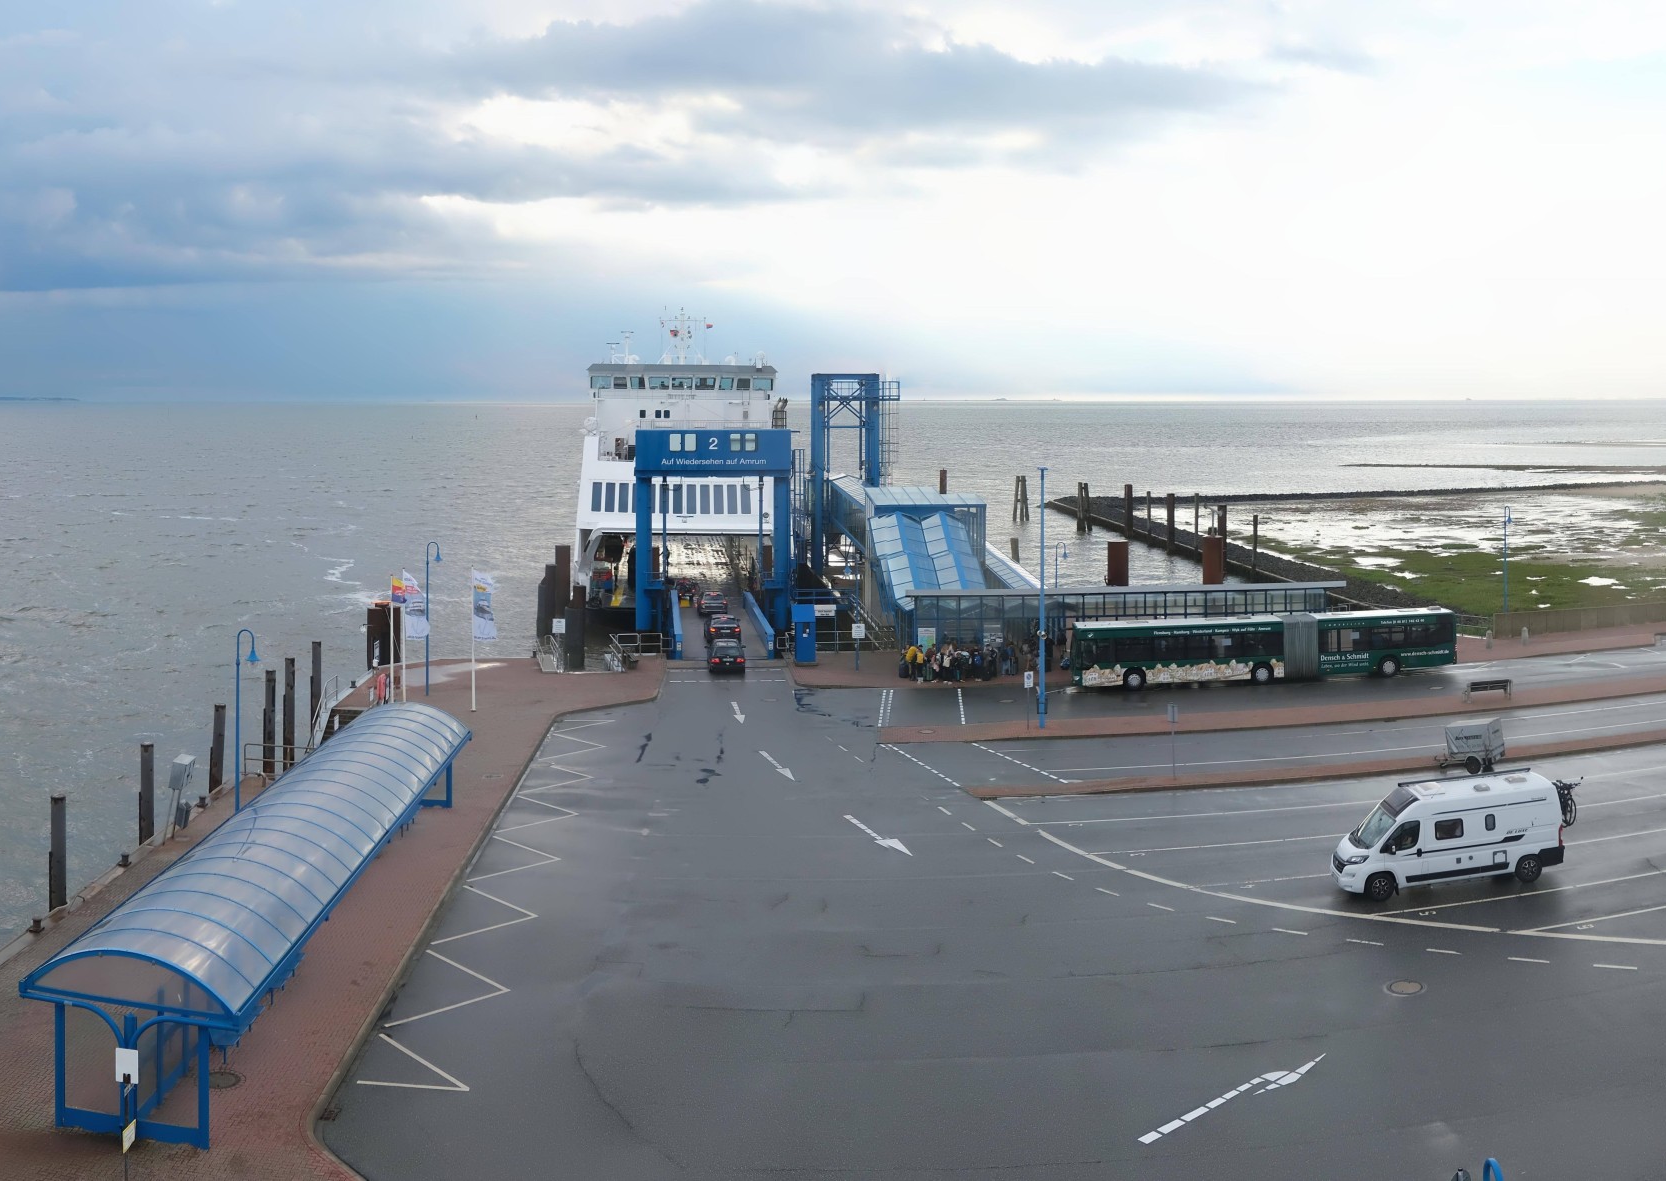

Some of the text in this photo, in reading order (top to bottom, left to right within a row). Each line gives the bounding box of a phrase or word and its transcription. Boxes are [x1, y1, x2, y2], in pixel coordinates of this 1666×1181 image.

[708, 437, 718, 450] 2
[1320, 653, 1341, 662] Densch
[1346, 652, 1369, 660] Schmidt
